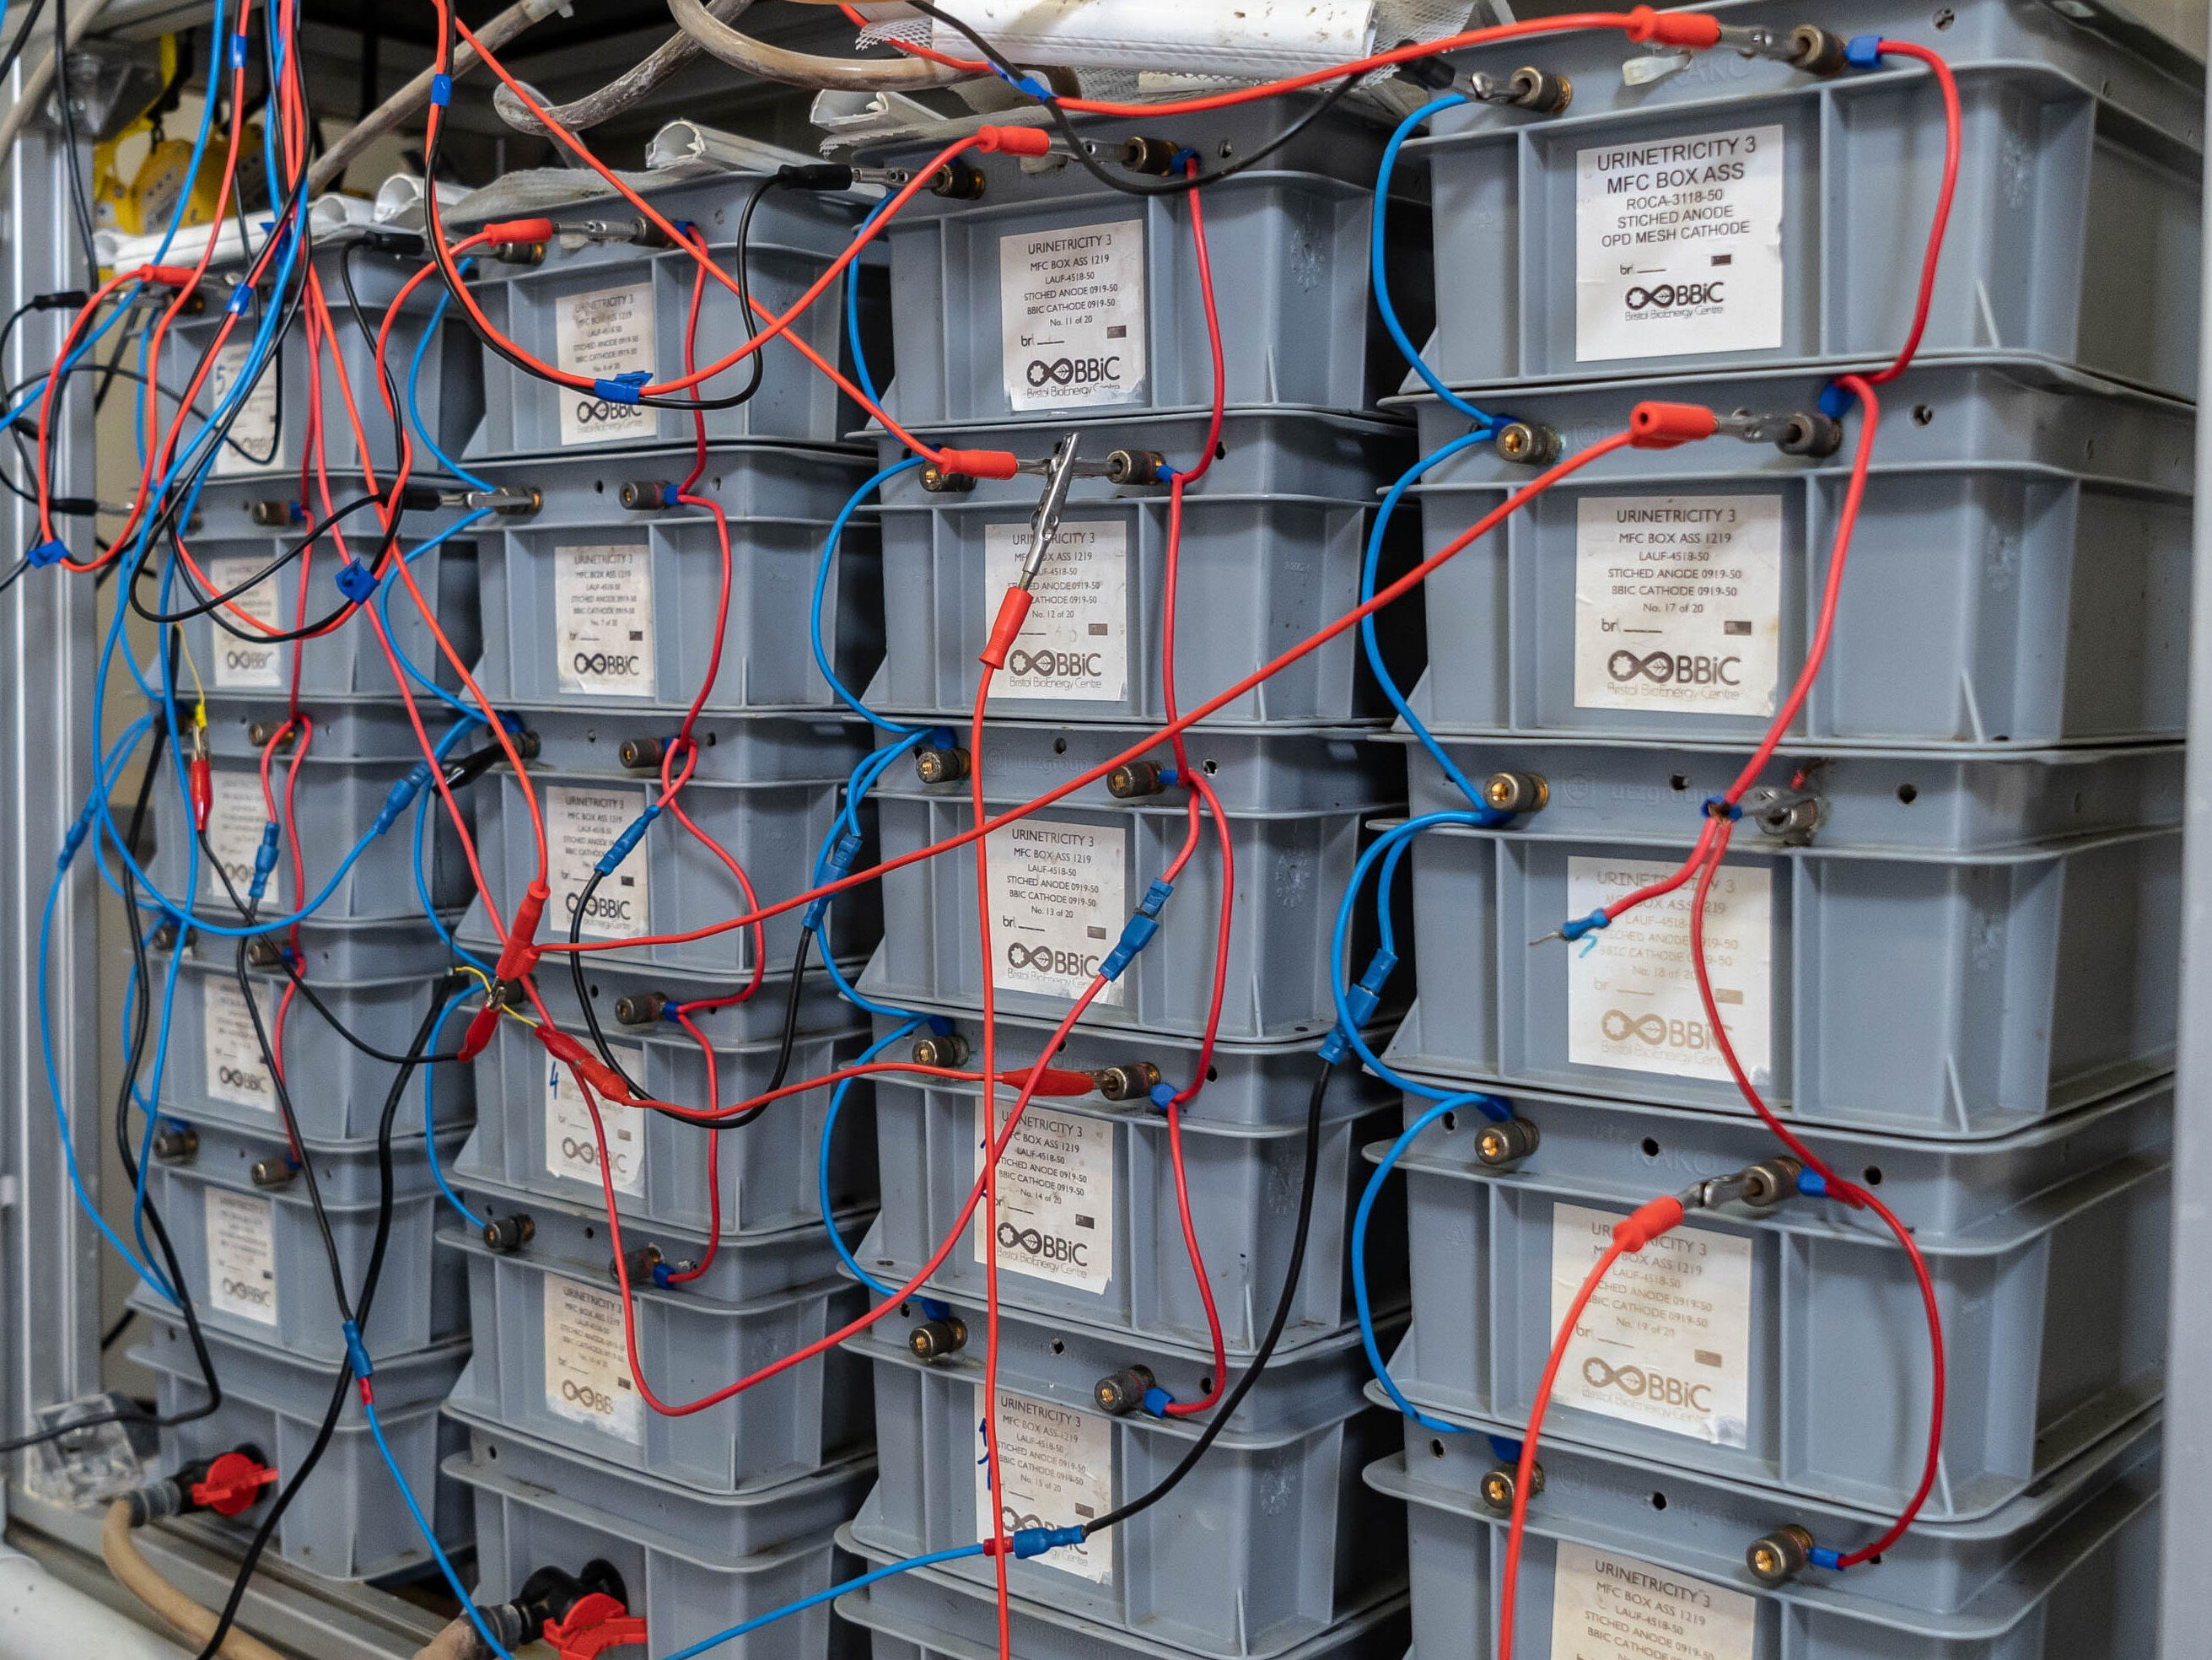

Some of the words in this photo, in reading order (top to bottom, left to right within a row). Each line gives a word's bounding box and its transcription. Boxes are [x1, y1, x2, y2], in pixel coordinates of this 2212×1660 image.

[1597, 137, 1739, 170] URINETRICITY
[1745, 136, 1756, 153] 3
[1607, 176, 1650, 194] MFC
[1656, 169, 1698, 189] BOX
[1703, 163, 1745, 183] ASS
[1627, 189, 1723, 211] ROCA-3118-50
[1617, 211, 1678, 229] STICHED
[1682, 206, 1734, 222] ANODE
[1601, 230, 1631, 247] OPD
[1636, 228, 1676, 244] MESH
[1680, 221, 1751, 240] CATHODE
[1028, 236, 1103, 255] URINETRICITY
[1106, 234, 1111, 245] 3
[1031, 261, 1048, 272] MFC
[1052, 258, 1070, 270] BOX
[1074, 256, 1088, 267] ASS
[1091, 255, 1109, 265] 1219
[1046, 272, 1095, 284] LAUF-4518-50
[1024, 291, 1056, 301] STICHED
[1059, 288, 1088, 298] ANODE
[1090, 284, 1118, 294] 0919-50
[1676, 282, 1724, 305] BBiC
[1027, 306, 1044, 315] BBIC
[1047, 302, 1085, 312] CATHODE
[1087, 299, 1115, 309] 0919-50
[1050, 318, 1063, 326] No.
[1084, 315, 1092, 324] 20
[1075, 357, 1120, 383] BBiC
[1617, 509, 1724, 523] URINETRICITY
[1729, 509, 1736, 522] 3
[1090, 533, 1095, 543] 3
[1619, 533, 1644, 543] MFC
[1649, 533, 1675, 543] BOX
[1680, 533, 1700, 543] ASS
[1706, 533, 1731, 543] 1219
[1639, 552, 1709, 561] LAUF-4518-50
[1607, 569, 1653, 579] STICHED
[1657, 569, 1699, 579] ANODE
[1702, 569, 1741, 579] 0919-50
[1612, 586, 1635, 595] BBIC
[1639, 586, 1694, 596] CATHODE
[1698, 587, 1737, 596] 0919-50
[1644, 603, 1660, 612] No.
[1680, 603, 1690, 612] of
[1693, 604, 1703, 612] 20
[1057, 653, 1102, 676] BBiC
[1676, 655, 1741, 686] BBiC
[1012, 829, 1085, 846] URINETRICITY
[1090, 837, 1095, 847] 3
[1015, 848, 1031, 857] MFC
[1034, 849, 1052, 860] BOX
[1055, 852, 1070, 861] ASS
[1074, 854, 1091, 864] 1219
[1028, 864, 1076, 876] LAUF-4518-50
[1007, 876, 1038, 886] STICHED
[1041, 880, 1069, 890] ANODE
[1072, 883, 1099, 893] 0919-50
[1726, 880, 1735, 893] 3
[1009, 890, 1026, 898] BBIC
[1029, 892, 1067, 903] CATHODE
[1068, 897, 1096, 908] 0919-50
[1031, 906, 1044, 914] No.
[1055, 951, 1100, 978] BBiC
[550, 1061, 558, 1099] 4
[1002, 1111, 1074, 1137] UNETRICITY
[1077, 1127, 1083, 1137] 3
[1023, 1135, 1041, 1145] BOX
[1044, 1139, 1058, 1149] ASS
[1062, 1142, 1079, 1153] 1219
[1017, 1147, 1064, 1164] LAUF-4518-50
[1031, 1163, 1058, 1177] ANODE
[1059, 1171, 1087, 1183] 0919-50
[999, 1170, 1015, 1181] BBIC
[1018, 1174, 1055, 1189] CATHODE
[1058, 1183, 1084, 1196] 0919-50
[1054, 1196, 1062, 1205] 20
[1044, 1235, 1087, 1267] BBiC
[1699, 1242, 1706, 1256] 3
[1652, 1258, 1672, 1270] ASS
[1677, 1263, 1703, 1275] 1219
[1631, 1288, 1671, 1303] ANODE
[1612, 1301, 1666, 1319] CATHODE
[1649, 1373, 1711, 1413] BBiC
[1001, 1396, 1073, 1423] URINETRICITY
[1076, 1417, 1081, 1427] 3
[1003, 1415, 1020, 1426] MFC
[1022, 1420, 1040, 1432] BOX
[1062, 1431, 1079, 1443] 1219
[1018, 1459, 1055, 1476] CATHODE
[1030, 1450, 1058, 1465] ANODE
[1058, 1459, 1085, 1473] 0919-50
[1035, 1479, 1043, 1487] 15
[1054, 1484, 1061, 1492] 20
[1595, 1560, 1698, 1602] URINETRICITY
[1703, 1594, 1710, 1608] 3
[1596, 1582, 1621, 1598] MFC
[1625, 1591, 1651, 1609] BOX
[1655, 1603, 1676, 1615] ASS
[1680, 1609, 1706, 1625] 1219
[1615, 1605, 1683, 1635] LAUF-4518-50
[1585, 1611, 1629, 1633] STICHED
[1632, 1628, 1672, 1648] ANODE
[1588, 1627, 1611, 1642] BBIC
